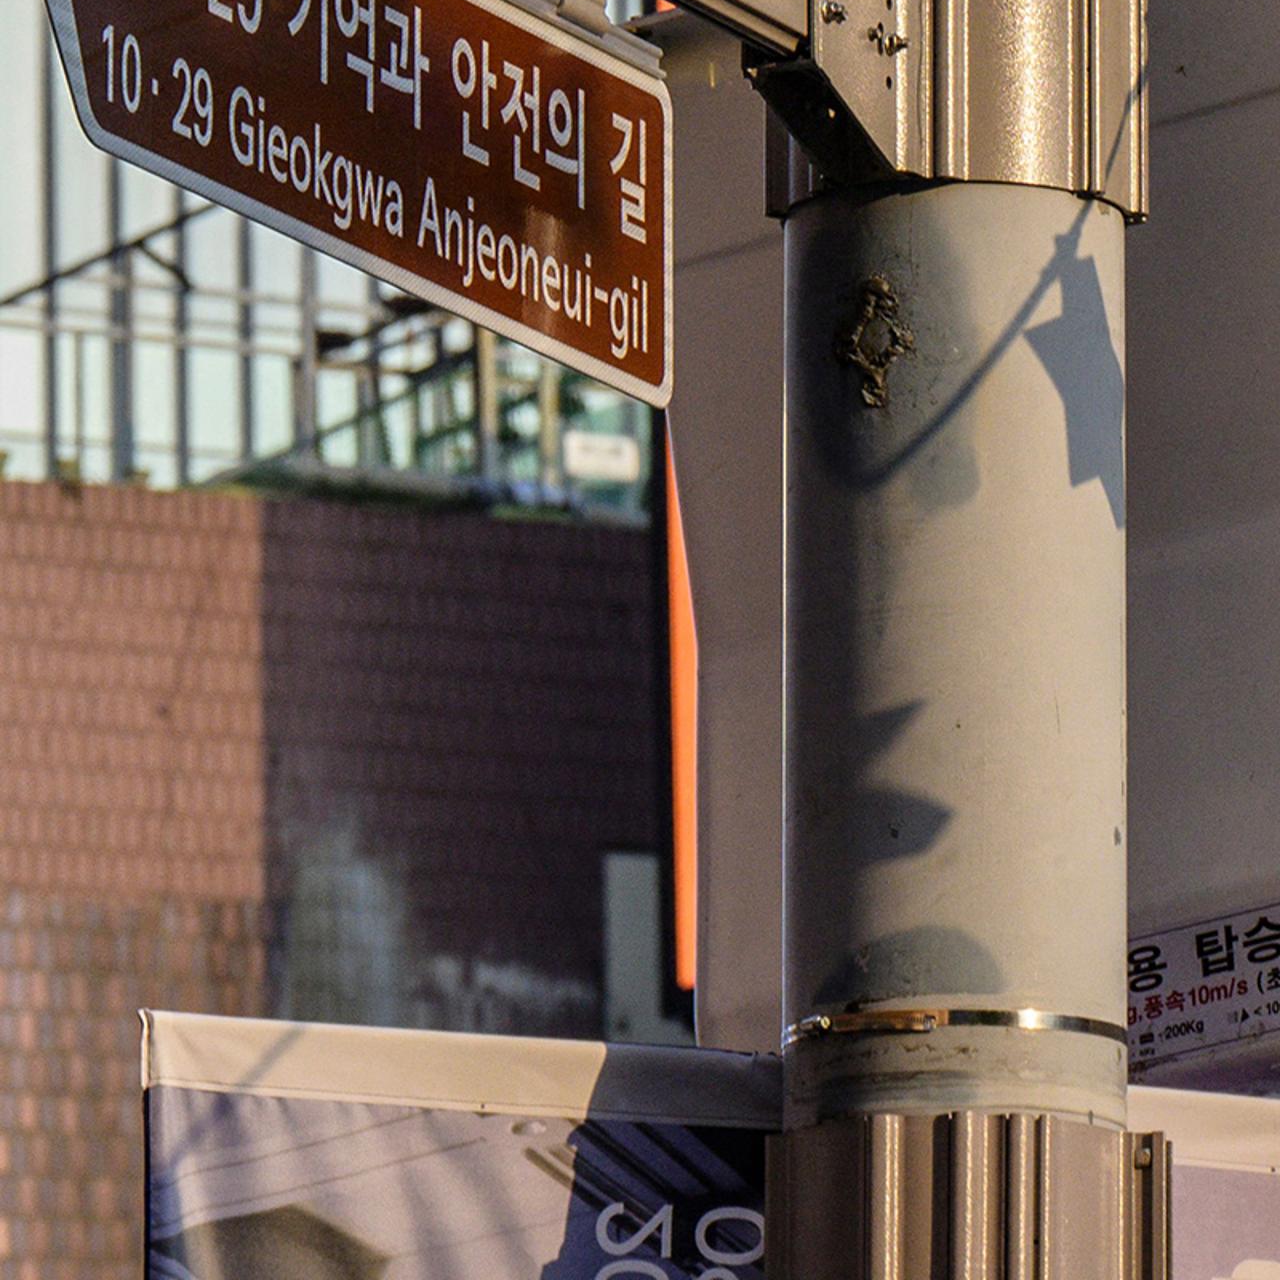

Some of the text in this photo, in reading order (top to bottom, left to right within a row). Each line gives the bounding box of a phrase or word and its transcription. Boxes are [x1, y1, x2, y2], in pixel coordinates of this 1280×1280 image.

[229, 85, 403, 234] Gieokgwa
[417, 176, 648, 359] Anjeoneui-gil
[452, 39, 585, 209] 안전의
[611, 113, 647, 244] 길
